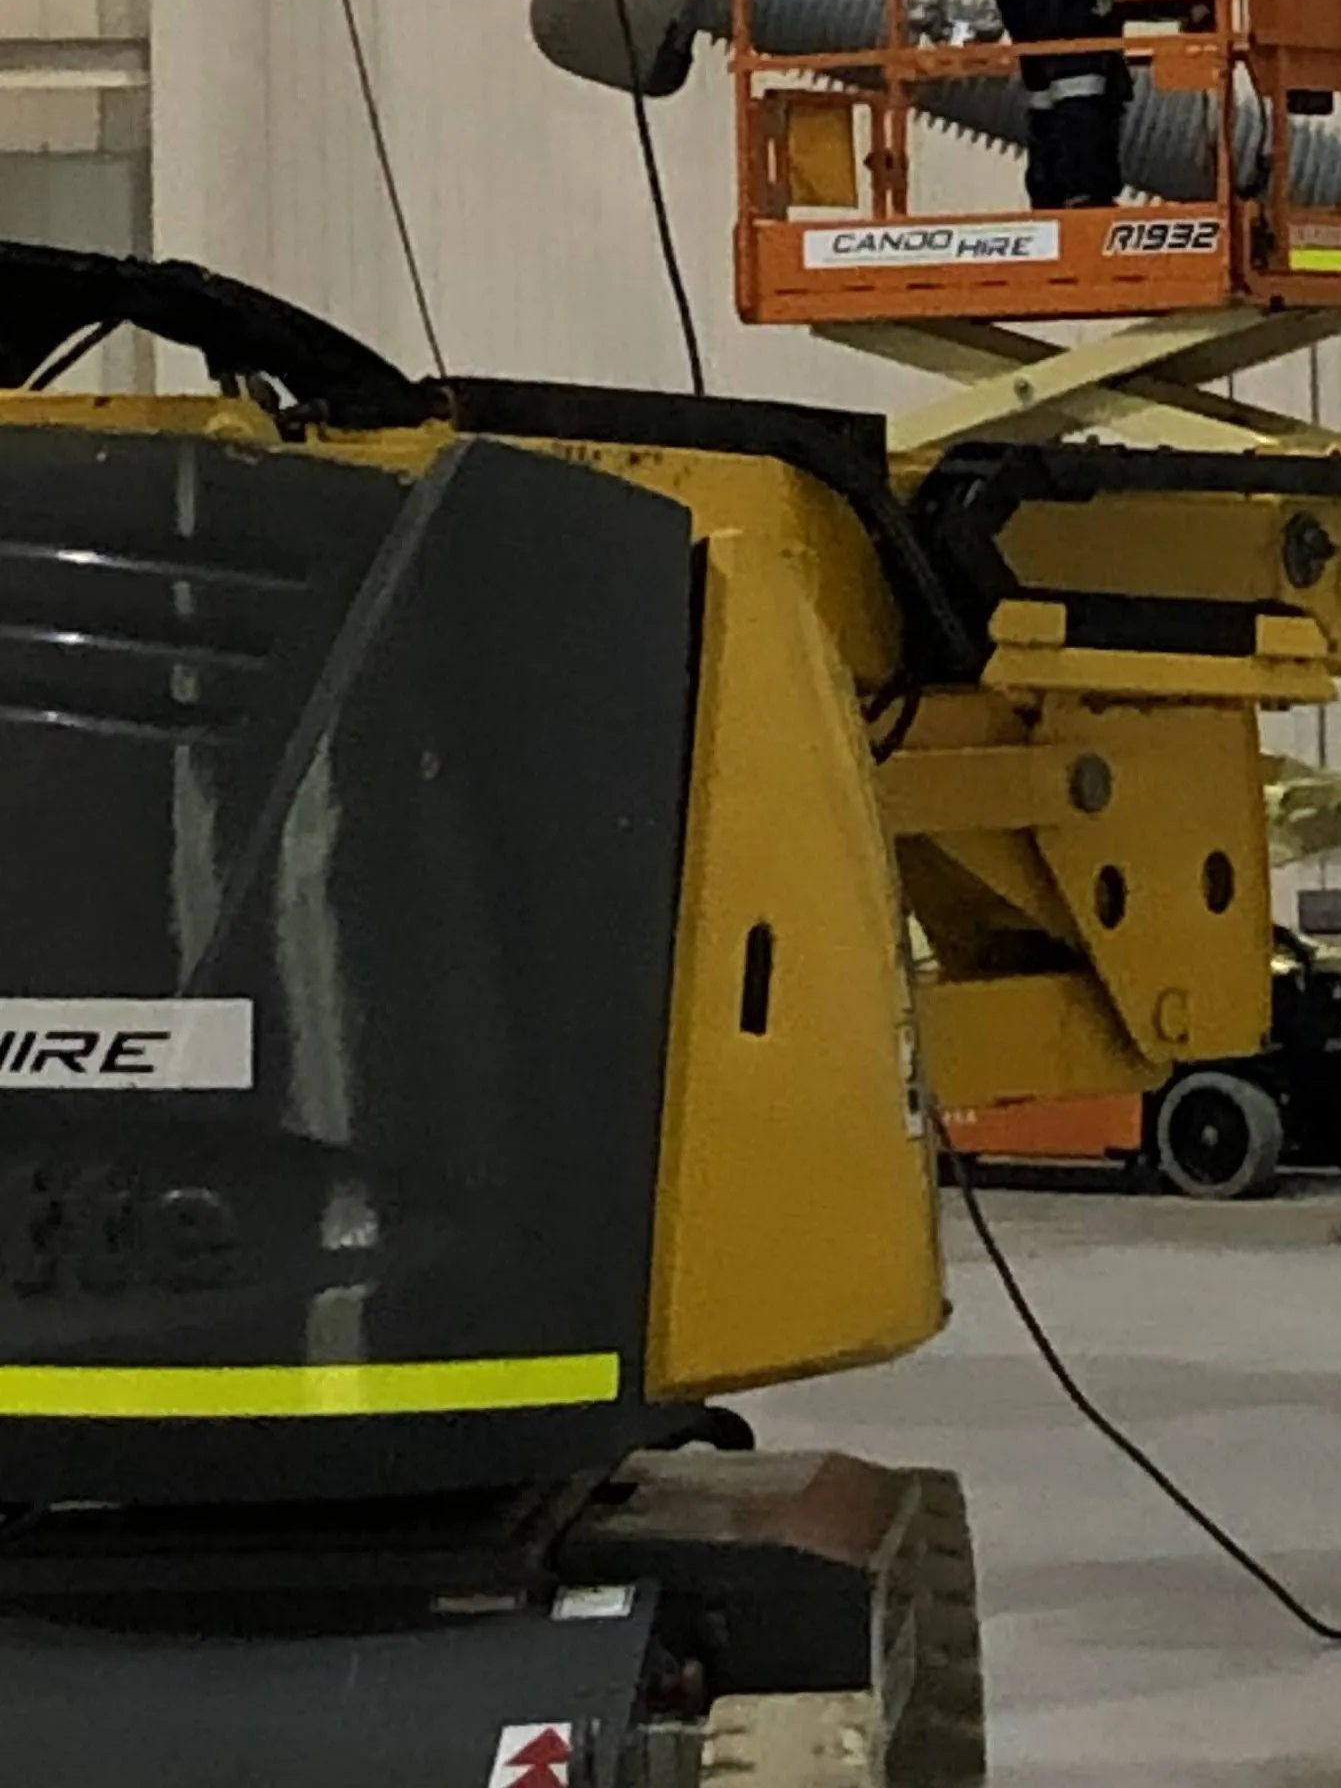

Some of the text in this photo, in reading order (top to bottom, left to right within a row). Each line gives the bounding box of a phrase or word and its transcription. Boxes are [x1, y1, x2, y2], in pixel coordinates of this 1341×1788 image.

[832, 230, 1033, 258] CANDO HIRE
[1107, 221, 1220, 251] R1932
